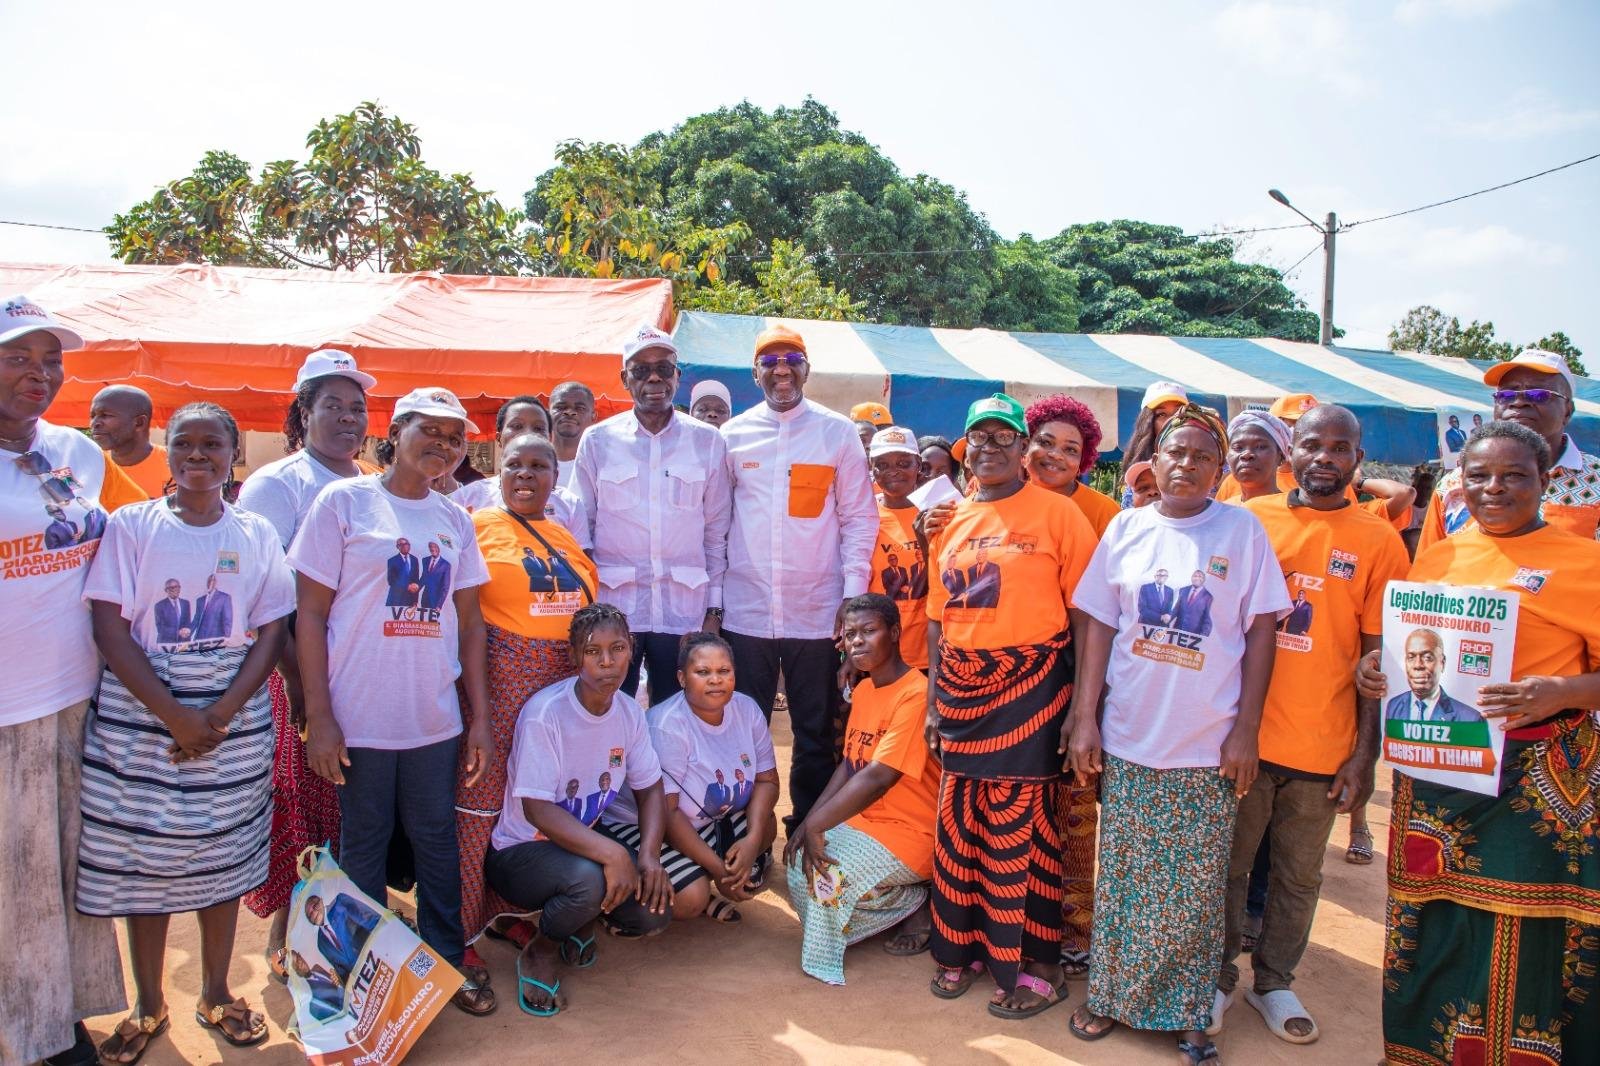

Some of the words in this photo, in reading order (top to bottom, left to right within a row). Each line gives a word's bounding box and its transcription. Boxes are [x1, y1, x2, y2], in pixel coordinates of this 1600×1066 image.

[0, 533, 44, 559] OTEZ
[881, 540, 922, 553] VOTE
[4, 558, 81, 580] AUGUSTIN
[1292, 573, 1325, 592] TEZ
[1390, 588, 1465, 616] Legislatives
[1467, 597, 1507, 620] 2025
[1400, 612, 1491, 634] YAMOUSSOUKRO
[1142, 626, 1203, 651] VOTEZ
[1403, 723, 1451, 742] VOTEZ
[1388, 742, 1435, 763] AUGUSTIN
[1437, 749, 1484, 768] THIAM
[373, 982, 434, 1064] YAMOUSSOUKRO
